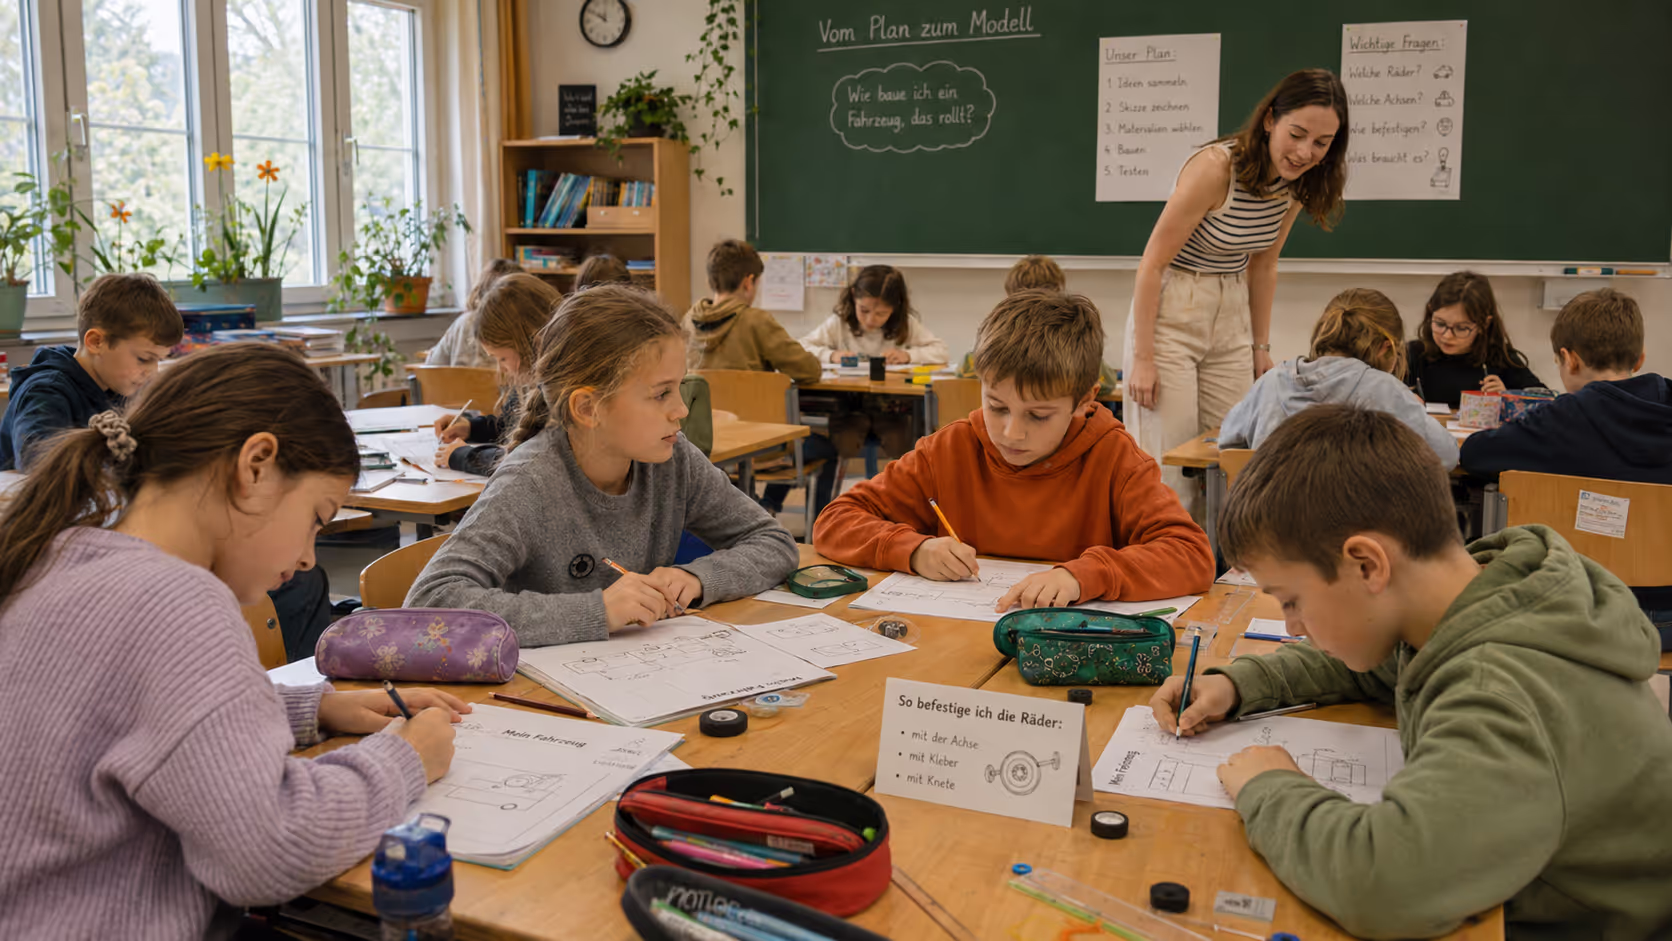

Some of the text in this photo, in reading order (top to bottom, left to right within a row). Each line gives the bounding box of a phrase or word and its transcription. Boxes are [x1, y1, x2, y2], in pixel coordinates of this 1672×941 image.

[819, 6, 1034, 43] Vom Plan zum Modell
[1350, 34, 1445, 53] Wichtige Fragen:
[1105, 45, 1177, 61] Unser Plan:
[1349, 64, 1422, 79] Welche Räder?
[1117, 76, 1144, 88] Ideen
[1147, 73, 1188, 87] sammeln
[848, 83, 958, 102] Wie baue ich ein
[1384, 91, 1424, 106] Achsen?
[1119, 101, 1147, 113] Skizze
[1151, 101, 1190, 112] zeichnen
[848, 104, 975, 134] Fahrzeug, das rollt?
[1118, 122, 1169, 134] Materialien
[1117, 143, 1147, 155] Bauen
[1371, 151, 1407, 164] braucht
[1412, 149, 1430, 163] es?
[1118, 165, 1149, 177] Testen
[898, 694, 1063, 730] So befestige ich die Räder:
[501, 729, 588, 749] Mein Fahrzeug
[911, 730, 980, 751] mit der Achse
[909, 751, 959, 768] mit Kleber
[907, 772, 956, 790] mit Knete
